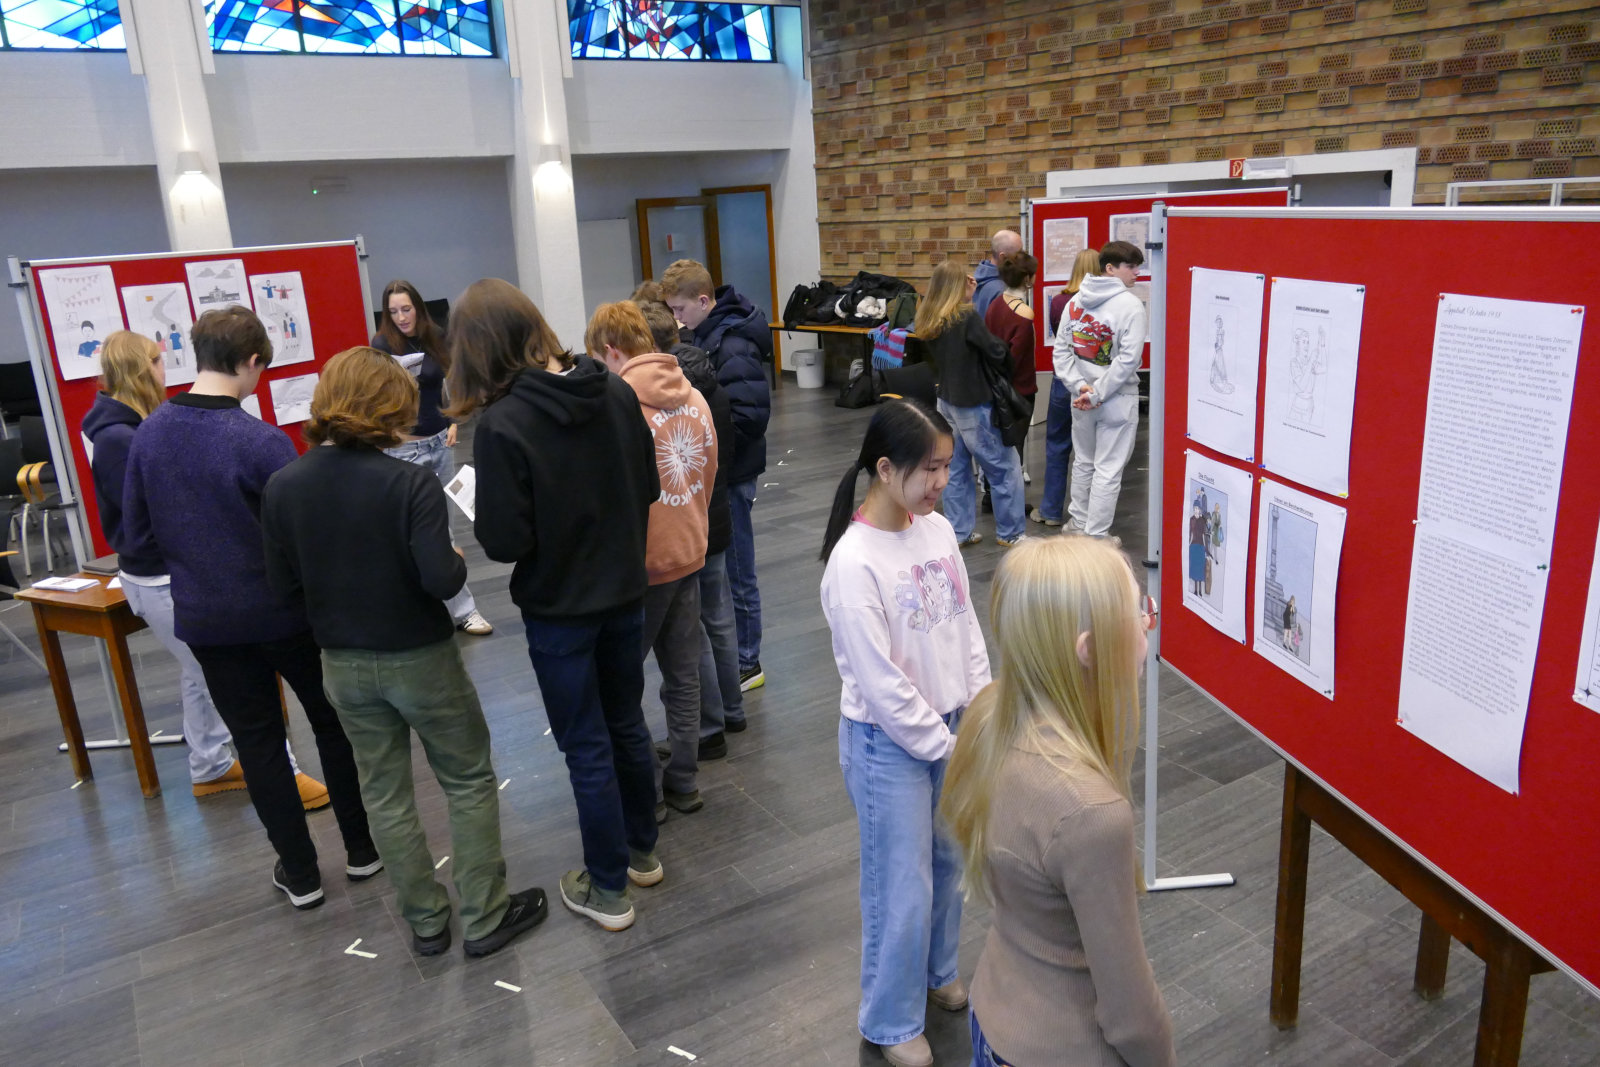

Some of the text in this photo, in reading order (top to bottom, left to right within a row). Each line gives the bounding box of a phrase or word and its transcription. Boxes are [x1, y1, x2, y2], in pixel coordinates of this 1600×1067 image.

[652, 404, 713, 447] RISING SUN
[658, 480, 703, 507] MYKON
